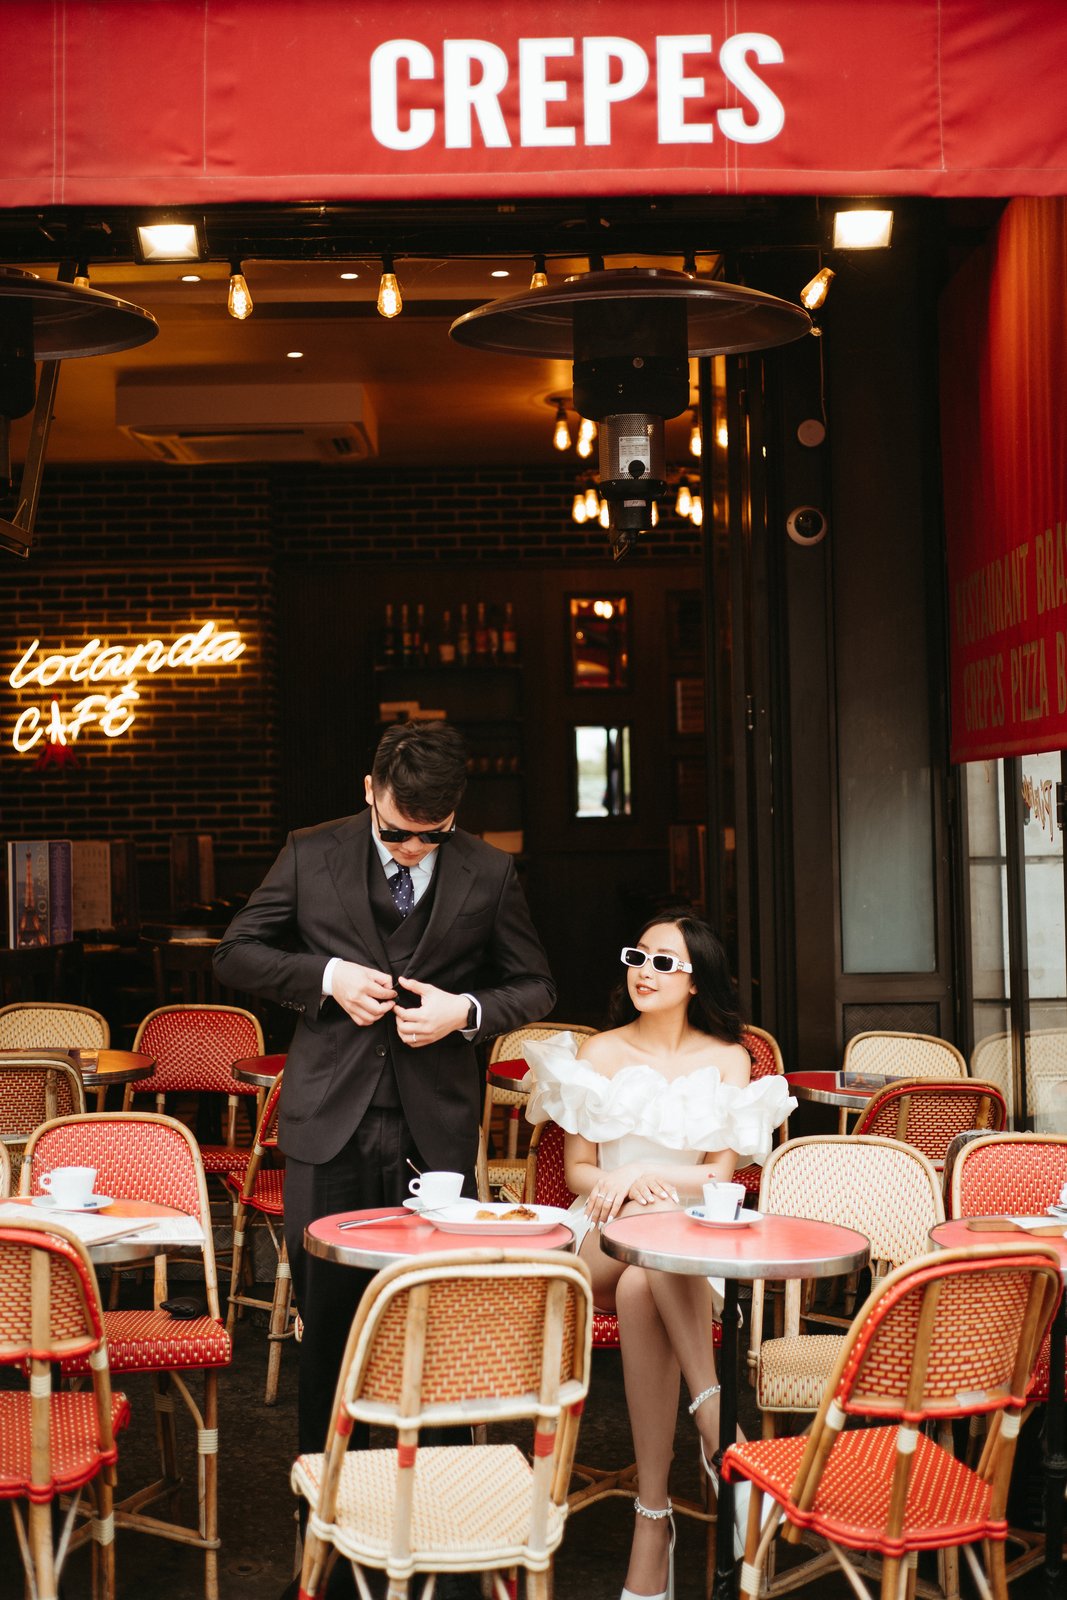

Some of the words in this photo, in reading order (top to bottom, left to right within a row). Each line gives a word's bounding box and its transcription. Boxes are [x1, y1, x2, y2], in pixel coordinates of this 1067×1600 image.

[370, 32, 786, 151] CREPES
[1035, 521, 1067, 616] BRA
[1010, 637, 1051, 723] PIZZA
